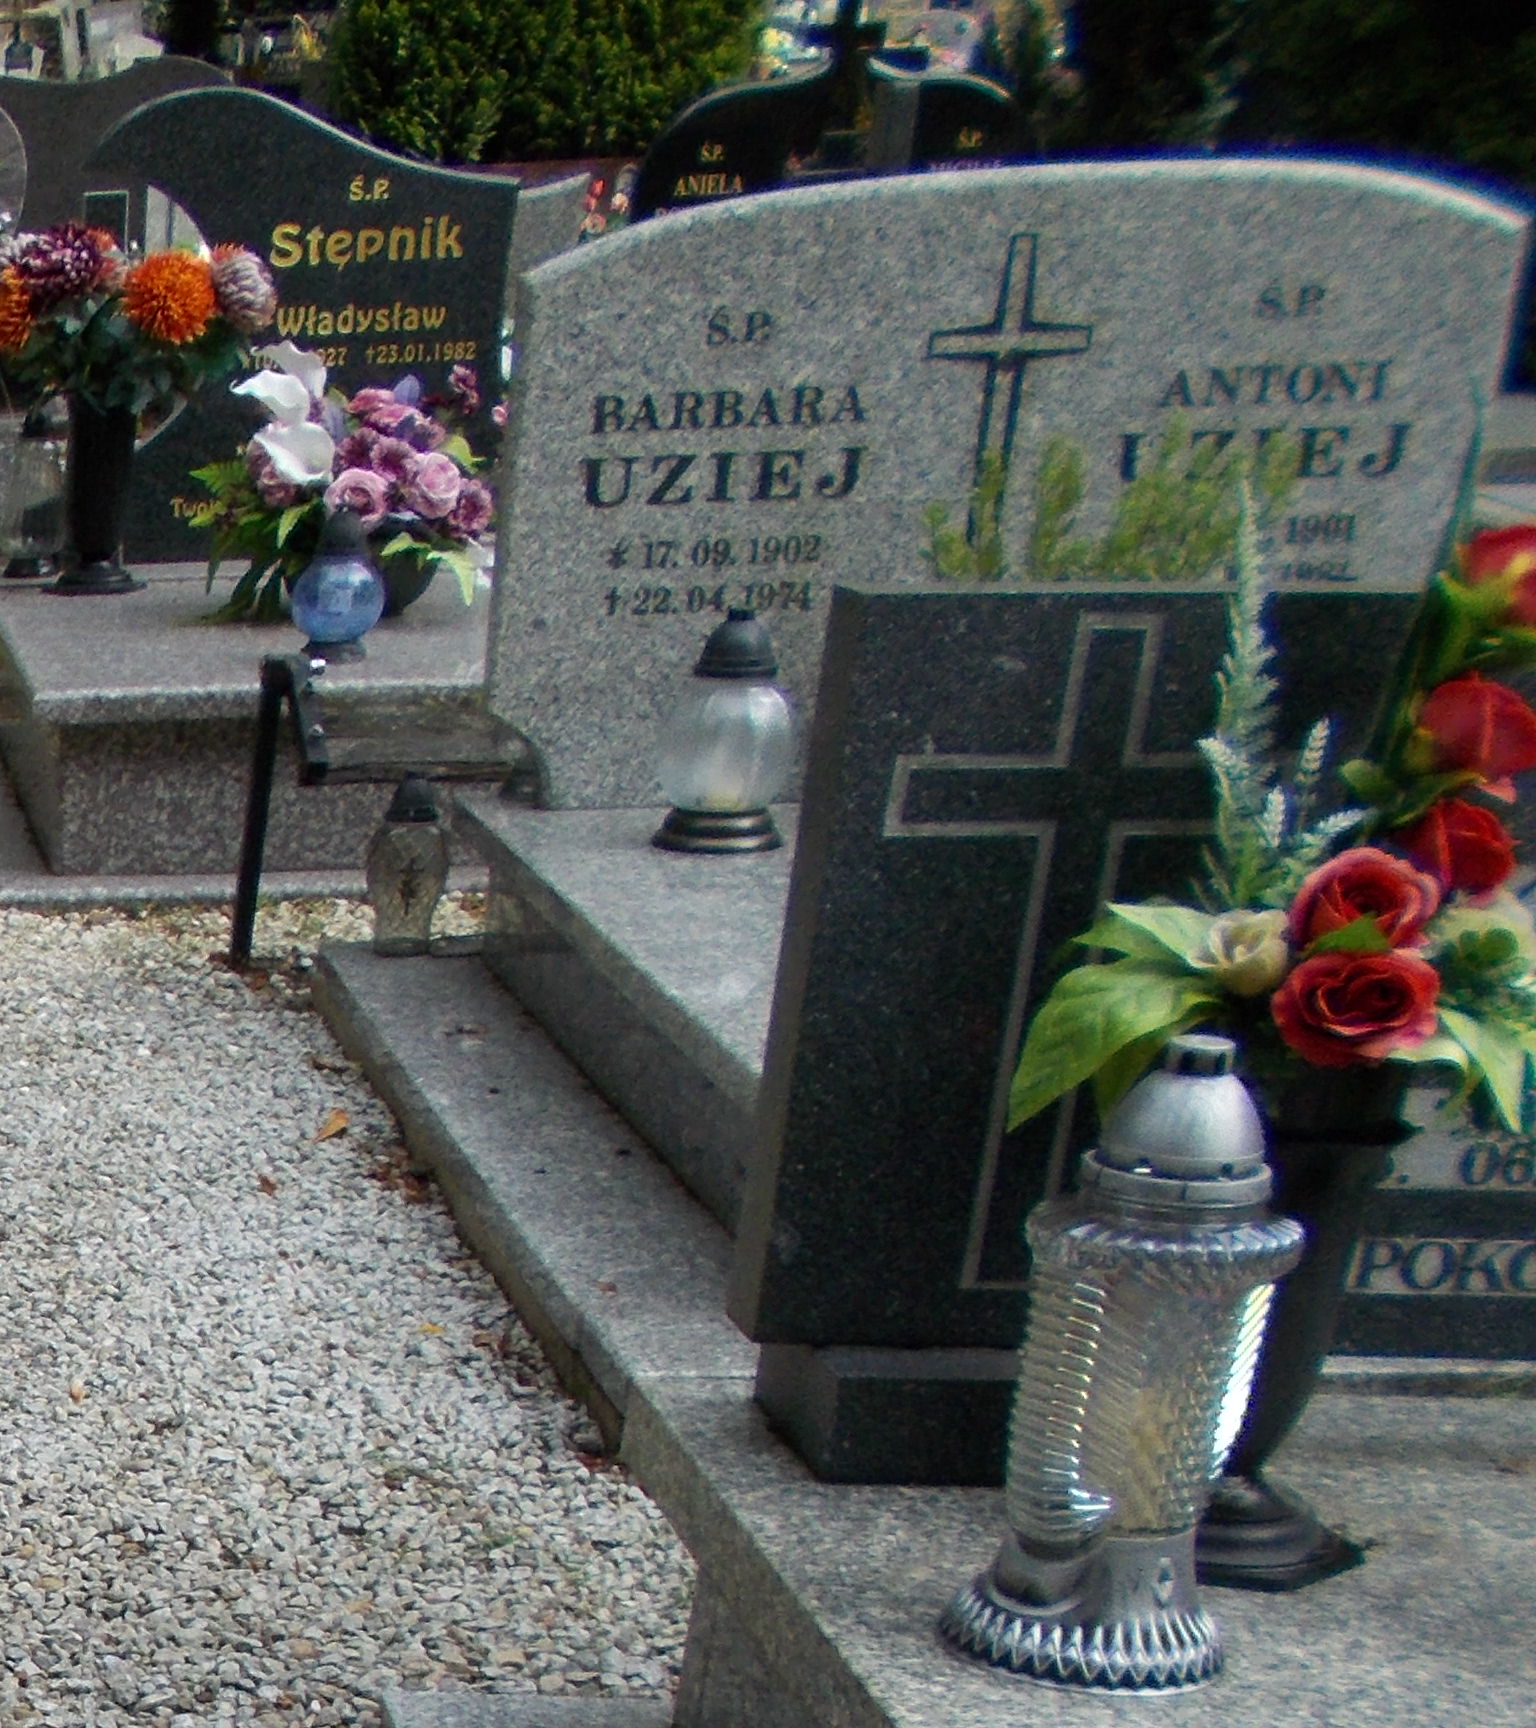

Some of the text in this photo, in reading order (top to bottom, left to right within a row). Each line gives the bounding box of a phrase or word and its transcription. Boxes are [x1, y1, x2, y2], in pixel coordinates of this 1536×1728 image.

[349, 175, 390, 201] Ś.P.
[674, 172, 744, 197] ANIELA
[269, 214, 465, 271] Stępnik
[278, 301, 449, 337] Władysław
[590, 383, 868, 435] BARBARA
[1156, 358, 1396, 409] ANTONI
[578, 445, 871, 509] UZIEJ
